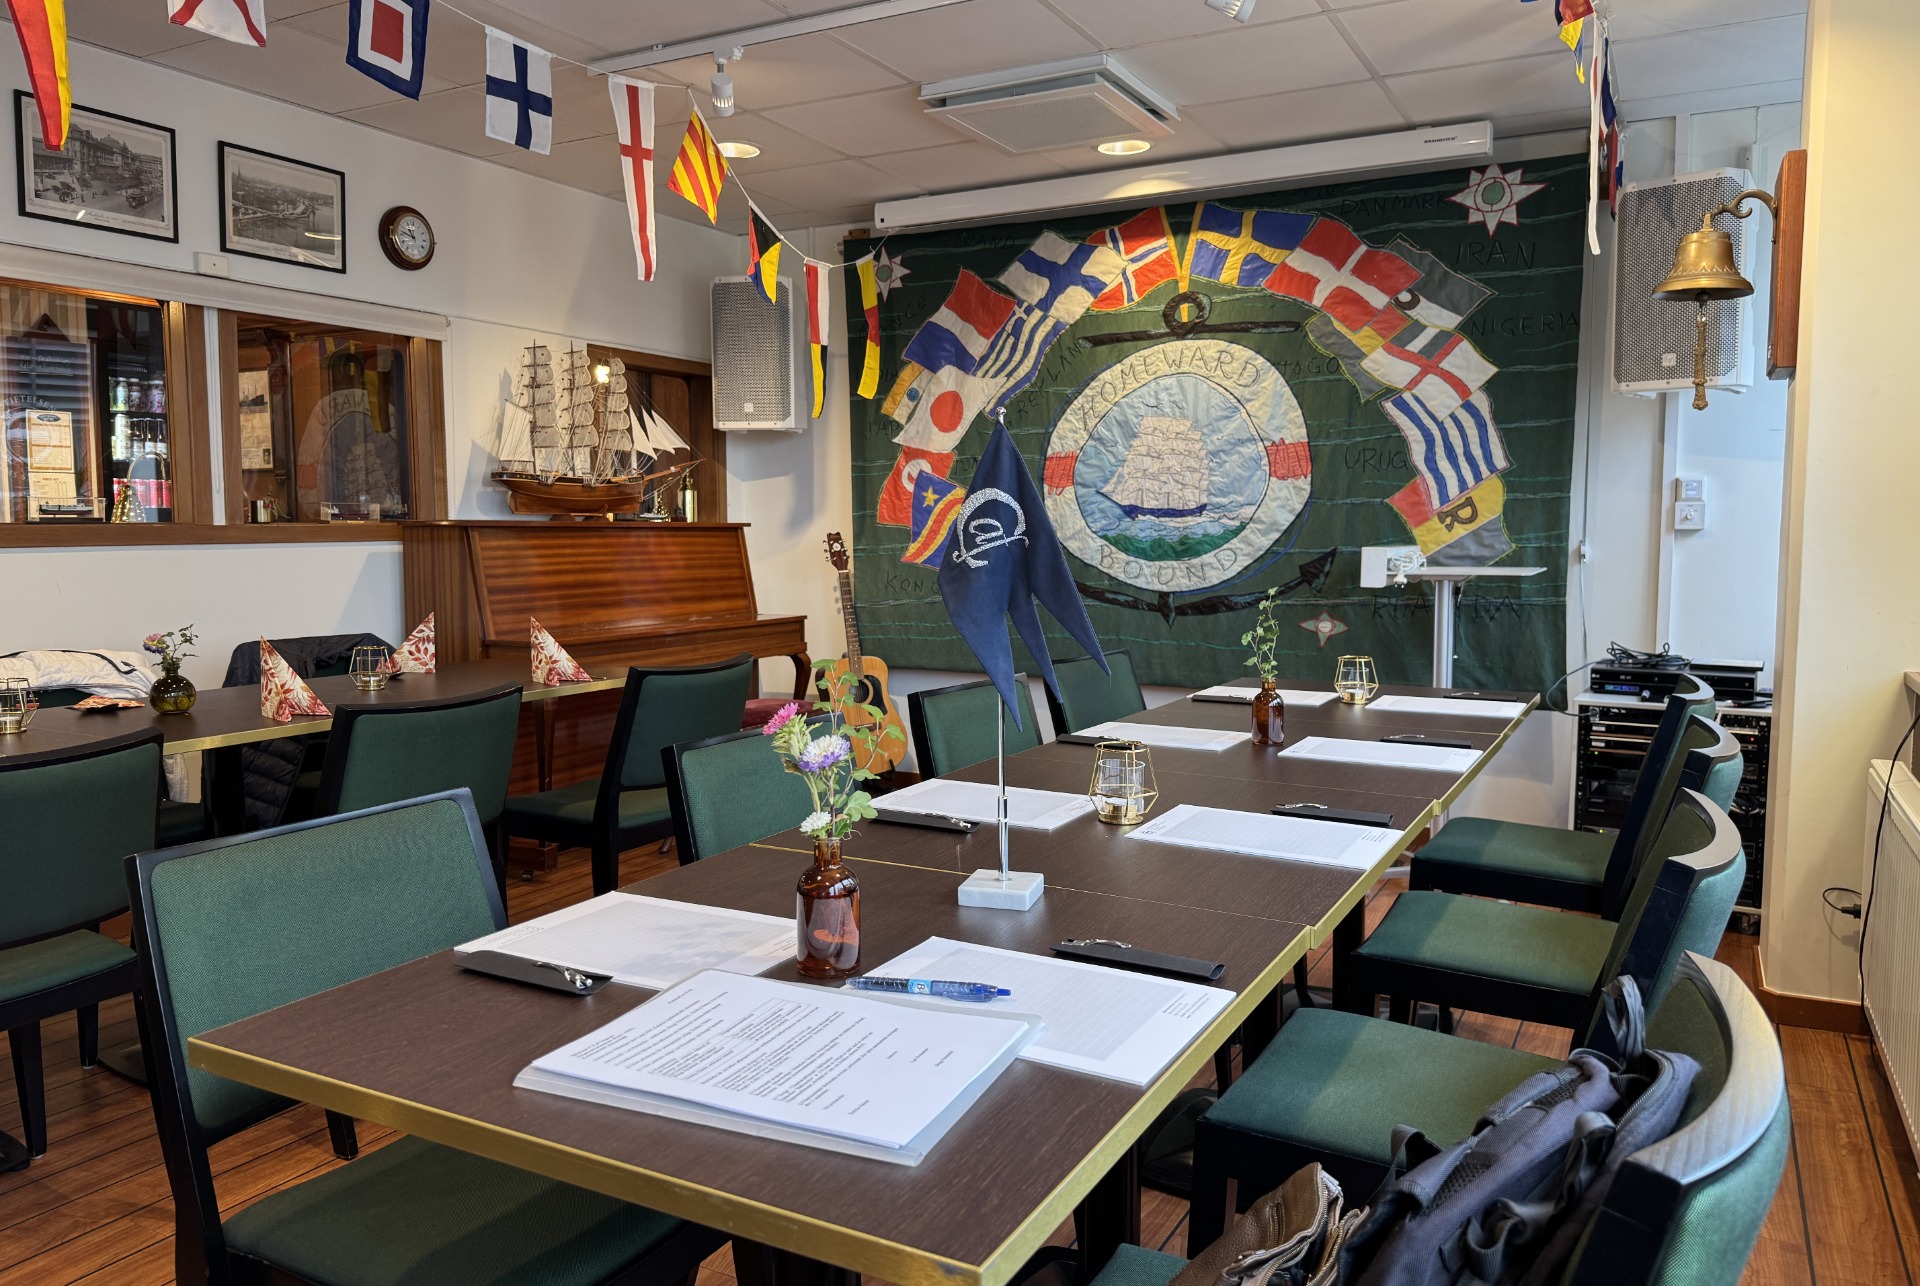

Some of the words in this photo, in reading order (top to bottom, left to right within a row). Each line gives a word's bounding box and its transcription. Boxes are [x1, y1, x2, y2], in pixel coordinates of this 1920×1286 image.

[1340, 190, 1450, 217] DANMARK
[1456, 239, 1536, 270] IRAN
[1470, 312, 1580, 338] NIGERIA
[1276, 356, 1341, 377] TOGO
[1007, 338, 1083, 429] REKLAN
[1078, 346, 1261, 432] HOMEWARD
[1437, 496, 1479, 532] R
[1098, 543, 1238, 587] BOUND
[1372, 592, 1521, 622] RUADA
